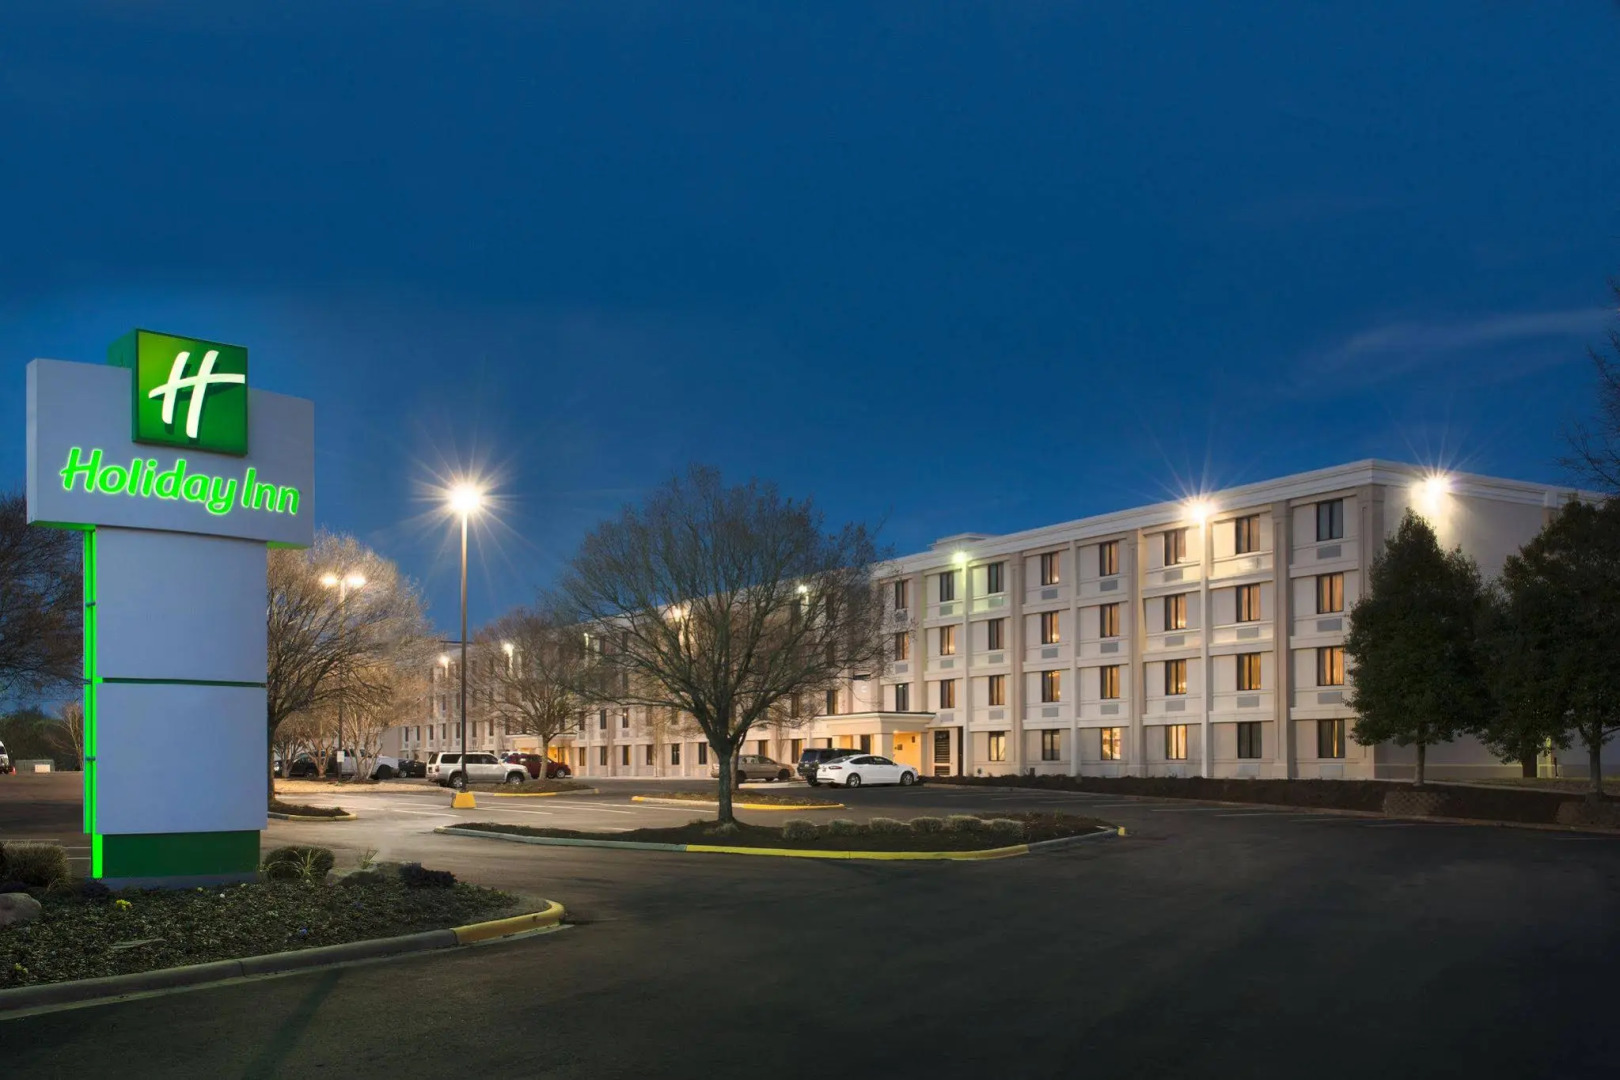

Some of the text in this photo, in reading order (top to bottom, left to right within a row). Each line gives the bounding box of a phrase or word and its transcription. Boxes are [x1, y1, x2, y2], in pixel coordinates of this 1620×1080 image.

[148, 350, 246, 438] H
[60, 447, 300, 515] Holiday Inn
